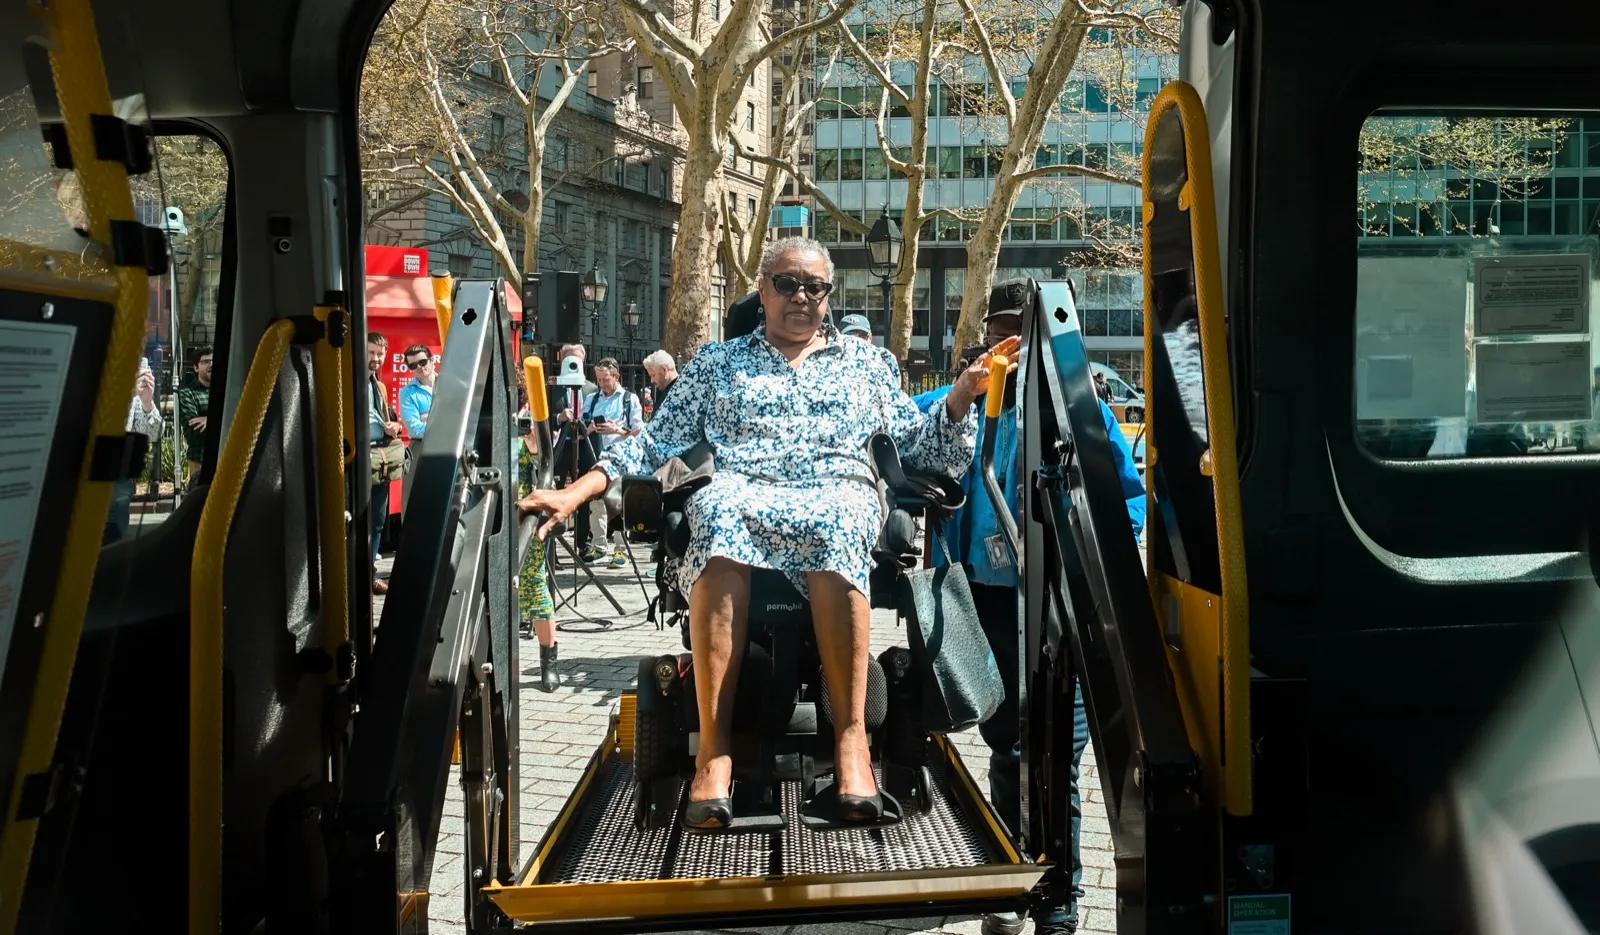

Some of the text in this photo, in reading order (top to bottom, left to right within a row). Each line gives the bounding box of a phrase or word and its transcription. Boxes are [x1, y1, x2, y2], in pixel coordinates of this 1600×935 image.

[766, 603, 803, 612] permobil
[1233, 901, 1264, 909] MANUAL
[1233, 908, 1276, 917] OPERATION
